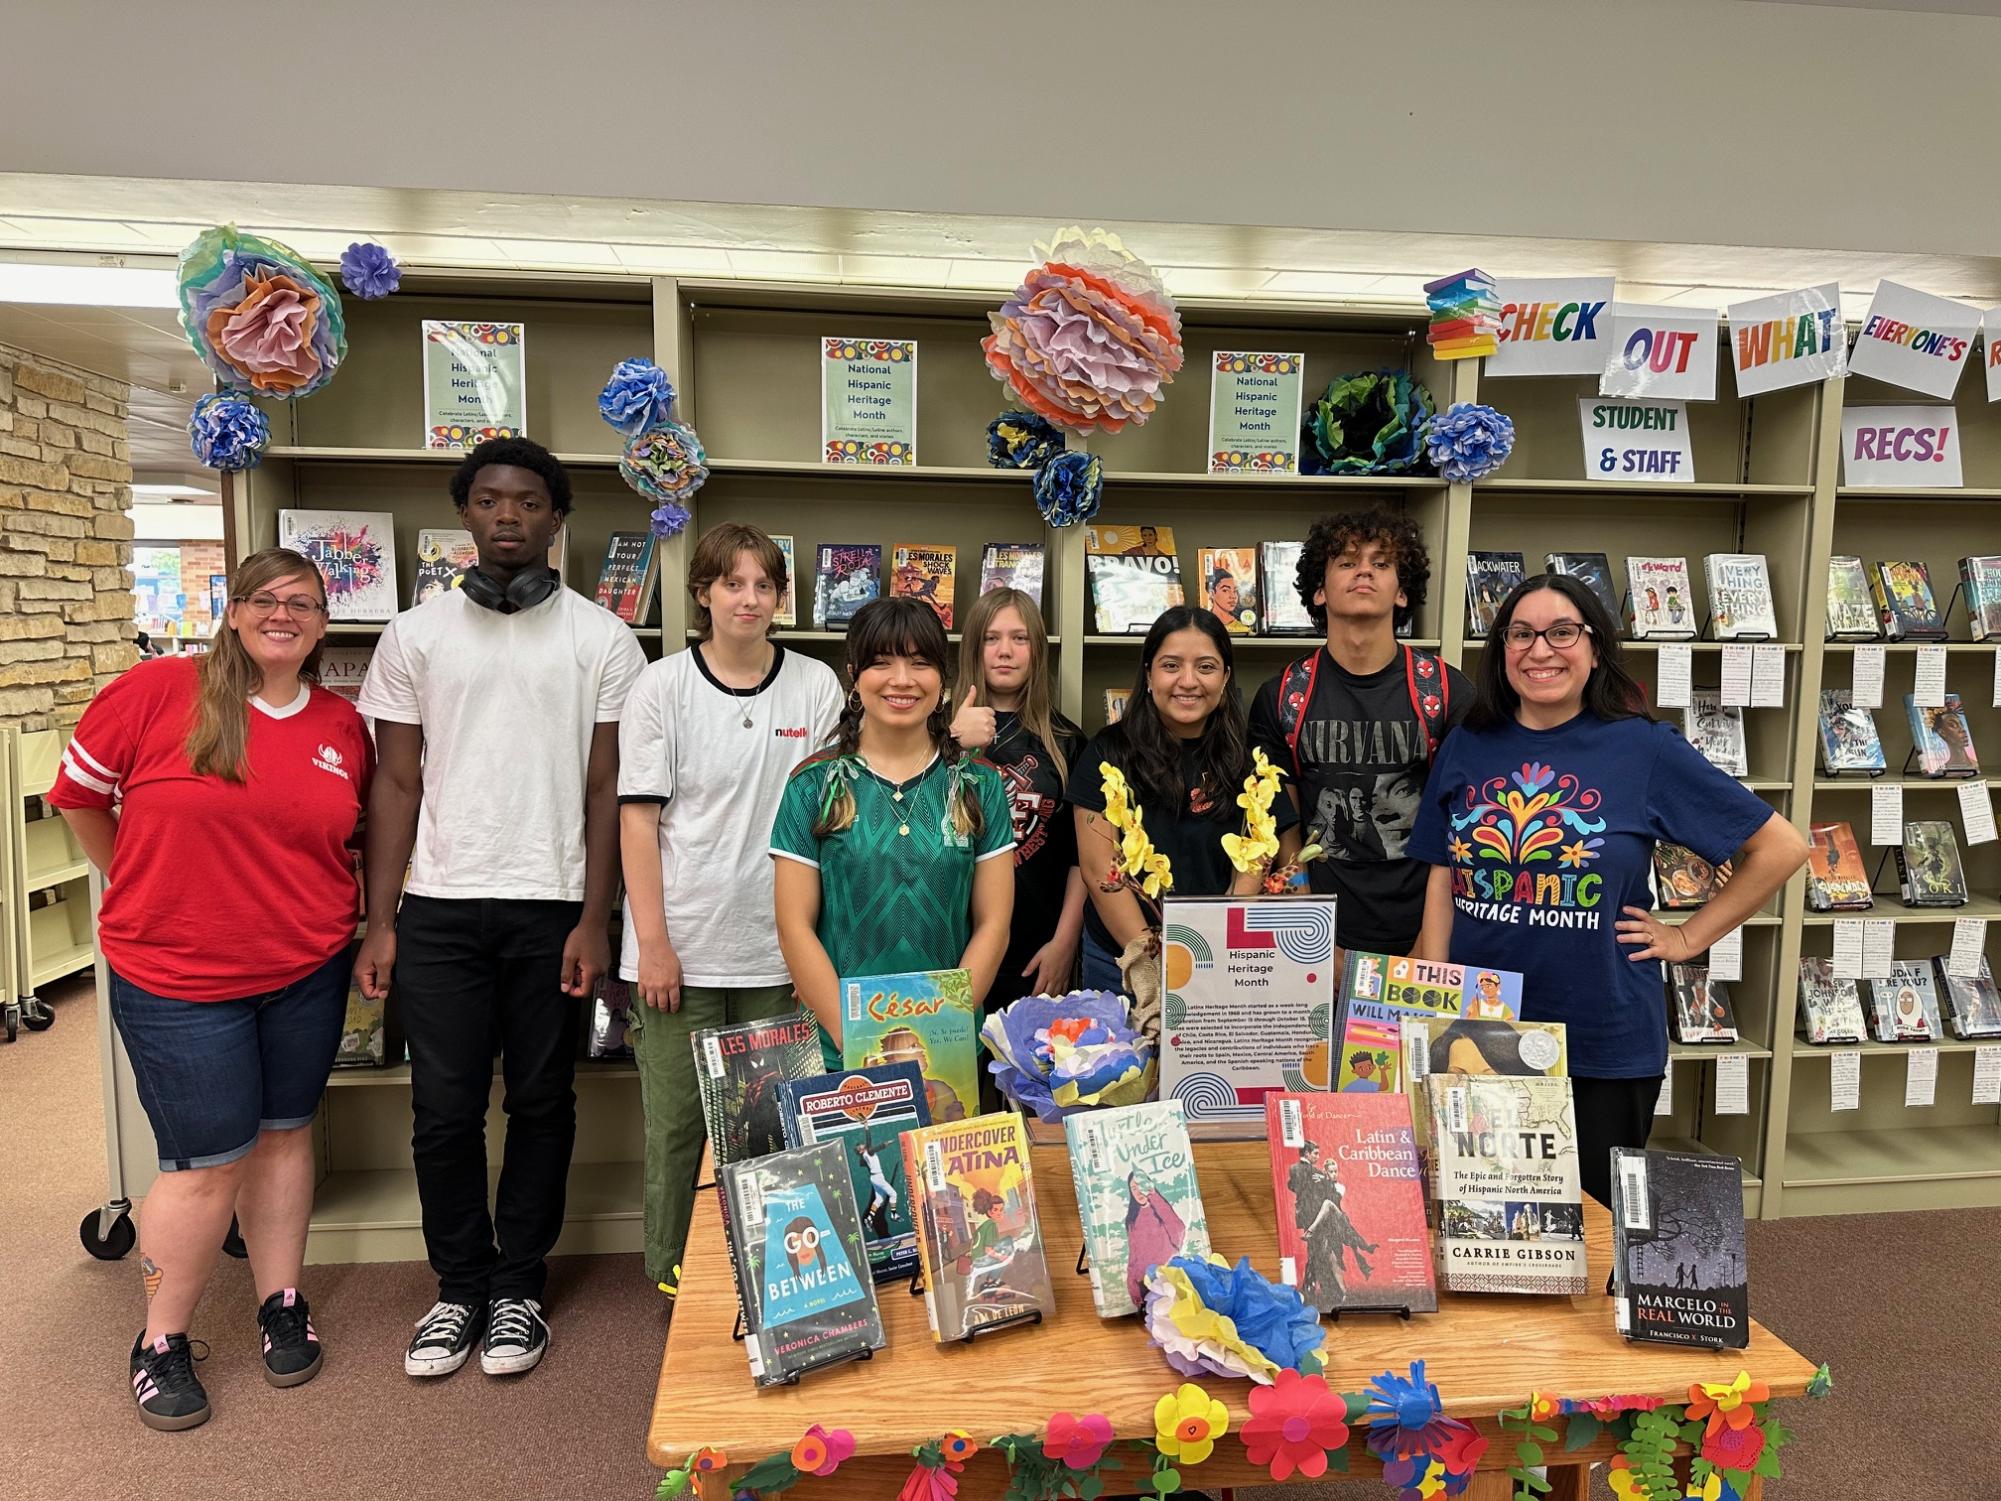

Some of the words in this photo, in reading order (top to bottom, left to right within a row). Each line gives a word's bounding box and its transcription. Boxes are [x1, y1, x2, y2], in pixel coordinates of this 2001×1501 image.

[1497, 301, 1606, 342] CHECK
[1623, 328, 1698, 373] OUT
[1739, 308, 1836, 371] WHAT
[1863, 315, 1967, 362] EVERYONE'S
[848, 364, 891, 374] National
[848, 379, 891, 391] Hispanic
[1237, 377, 1278, 386] National
[848, 394, 891, 406] Heritage
[1235, 392, 1277, 402] Hispanic
[853, 411, 886, 420] Month
[1234, 407, 1277, 417] Heritage
[1592, 405, 1678, 431] STUDENT
[1239, 422, 1271, 430] Month
[1854, 427, 1949, 462] RECS!
[1600, 448, 1617, 472] &
[1622, 449, 1682, 475] STAFF
[918, 553, 953, 562] MORALES
[923, 561, 950, 569] SHOCK
[927, 567, 952, 575] WAVES
[1088, 555, 1180, 575] BRAVO!
[1475, 561, 1521, 573] ACKWATER
[1725, 565, 1760, 576] VERY
[1727, 577, 1763, 588] HING
[598, 587, 637, 595] DAUGHTER
[775, 728, 808, 737] nutell
[1299, 719, 1428, 765] NIRVANA
[1455, 896, 1521, 924] HERITAGE
[1529, 909, 1600, 930] MONTH
[1229, 950, 1275, 962] Hispanic
[1227, 964, 1274, 976] Heritage
[1416, 965, 1461, 986] THIS
[1892, 969, 1912, 978] UDA
[1234, 978, 1269, 987] Month
[1901, 978, 1927, 986] YOU?
[1387, 984, 1460, 1011] BOOK
[867, 992, 945, 1022] César
[1353, 1003, 1383, 1019] WILL
[718, 1035, 747, 1056] LES
[749, 1023, 811, 1051] MORALES
[806, 1094, 853, 1112] ROBERTO
[855, 1085, 908, 1103] CLEMENTE
[933, 1126, 1015, 1154] NDERCOVER
[1356, 1128, 1396, 1144] Latin
[1400, 1130, 1412, 1144] &
[1116, 1133, 1168, 1162] Under
[1339, 1145, 1413, 1160] Caribbean
[945, 1146, 1019, 1176] ATINA
[1139, 1151, 1186, 1174] Ice
[1368, 1162, 1417, 1177] Dance
[1454, 1171, 1468, 1180] The
[1470, 1171, 1486, 1182] Epic
[1488, 1171, 1503, 1180] and
[1542, 1173, 1564, 1184] Story
[1459, 1184, 1467, 1195] of
[1468, 1184, 1503, 1195] Hispanic
[1505, 1185, 1528, 1194] North
[1530, 1186, 1562, 1195] America
[786, 1198, 806, 1212] THE
[783, 1228, 832, 1254] GO-
[1453, 1247, 1510, 1259] CARRIE
[1517, 1249, 1575, 1260] GIBSON
[768, 1261, 852, 1302] BETWEEN
[1638, 1293, 1717, 1313] MARCELO
[1638, 1307, 1675, 1322] REAL
[1678, 1312, 1736, 1328] WORLD
[774, 1335, 820, 1355] VERONICA
[822, 1319, 868, 1340] CHAMBERS
[1650, 1329, 1689, 1340] FRANCISCO
[1700, 1334, 1724, 1343] STORK
